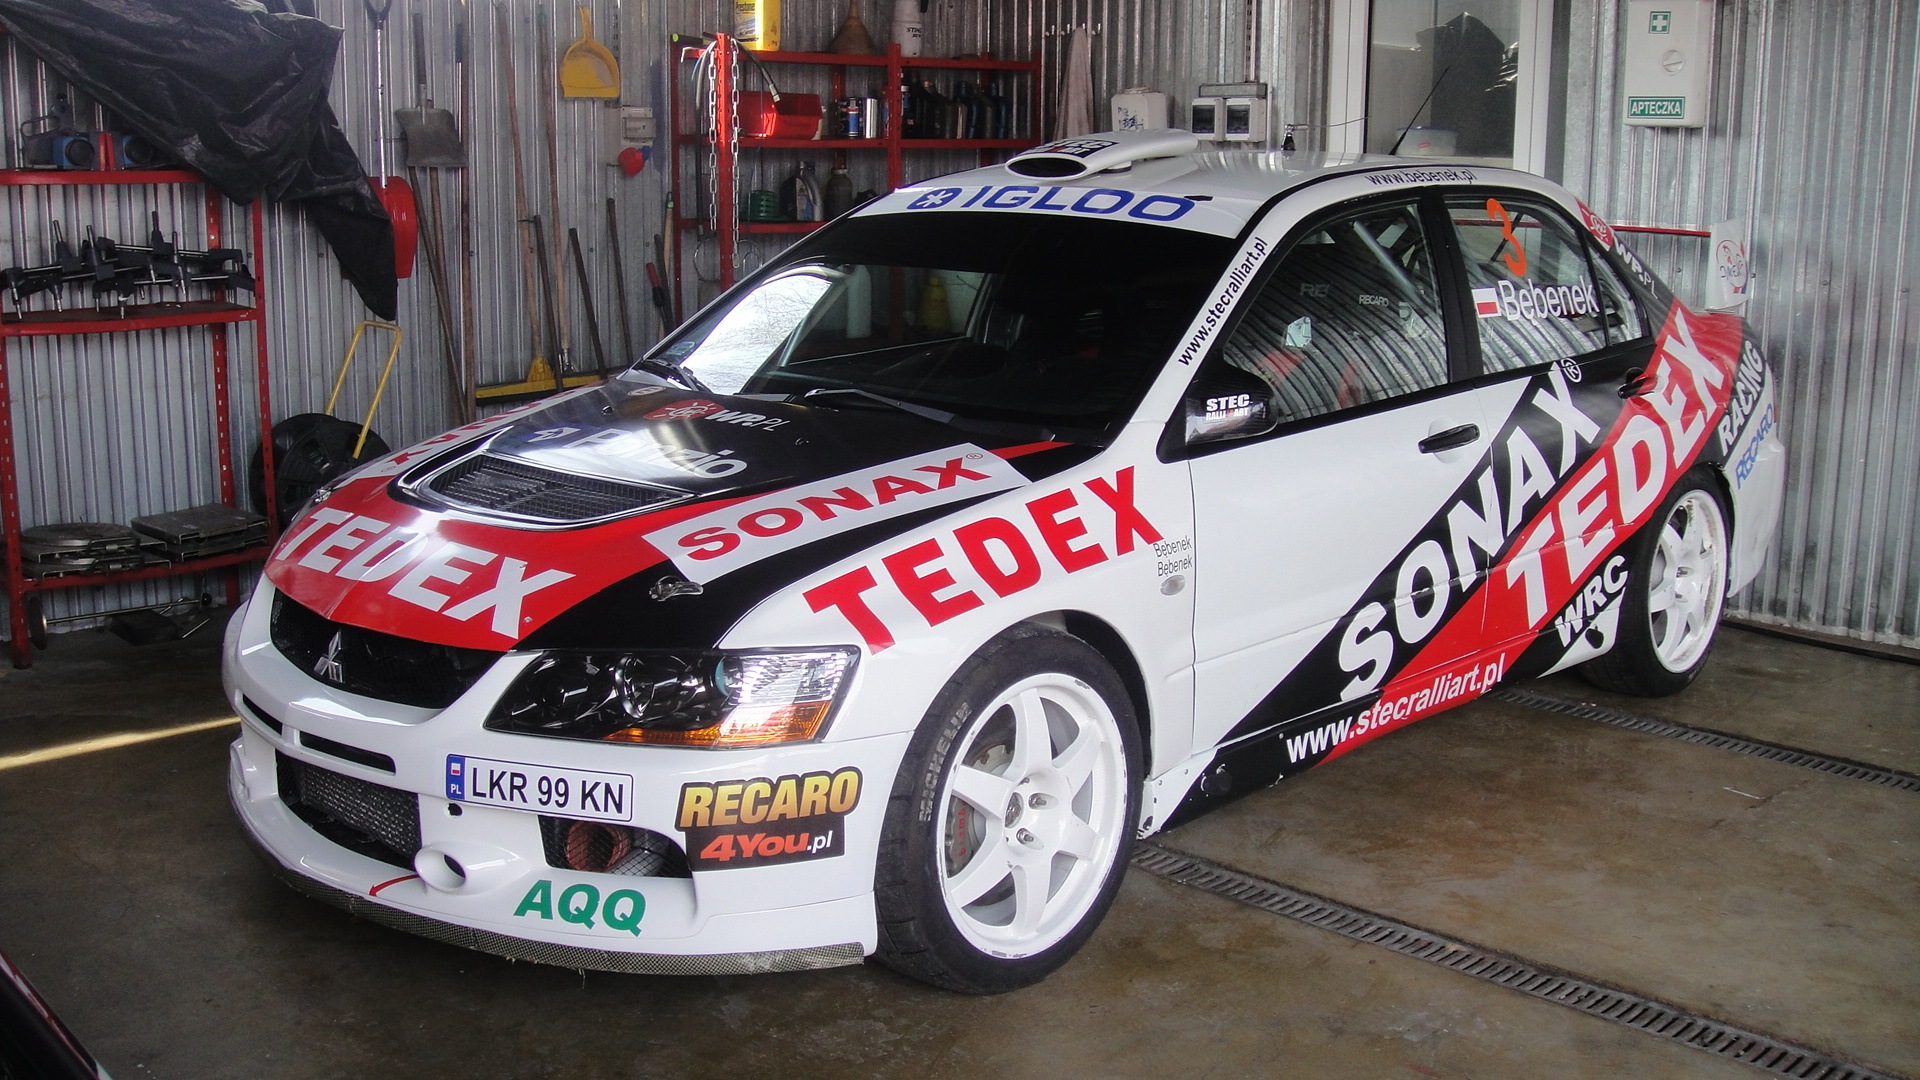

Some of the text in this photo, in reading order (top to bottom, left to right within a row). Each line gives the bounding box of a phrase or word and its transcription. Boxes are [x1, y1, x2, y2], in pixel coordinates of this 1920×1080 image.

[1631, 101, 1681, 115] APTECZKA
[960, 186, 1196, 222] IGLOO
[1486, 197, 1527, 278] 3
[1178, 236, 1268, 366] www.stecralliart.pl
[1359, 294, 1389, 307] RECARO
[1498, 275, 1600, 326] Bębenek
[705, 409, 791, 432] WP.PL
[1206, 394, 1250, 411] STEC
[1718, 340, 1763, 457] RACING
[1506, 307, 1725, 630] TEDEX
[1735, 403, 1774, 490] RECARO
[678, 457, 993, 561] SONAX
[1339, 362, 1600, 702] SONAX
[275, 507, 577, 640] TEDEX
[802, 465, 1165, 656] TEDEX
[1555, 555, 1629, 648] WRC
[1286, 652, 1506, 764] www.stecralliart.pl
[450, 783, 462, 796] PL
[472, 767, 624, 815] LKR 99 KN
[679, 770, 860, 829] RECARO
[700, 829, 833, 862] 4You.pl
[513, 879, 647, 938] AQQ
